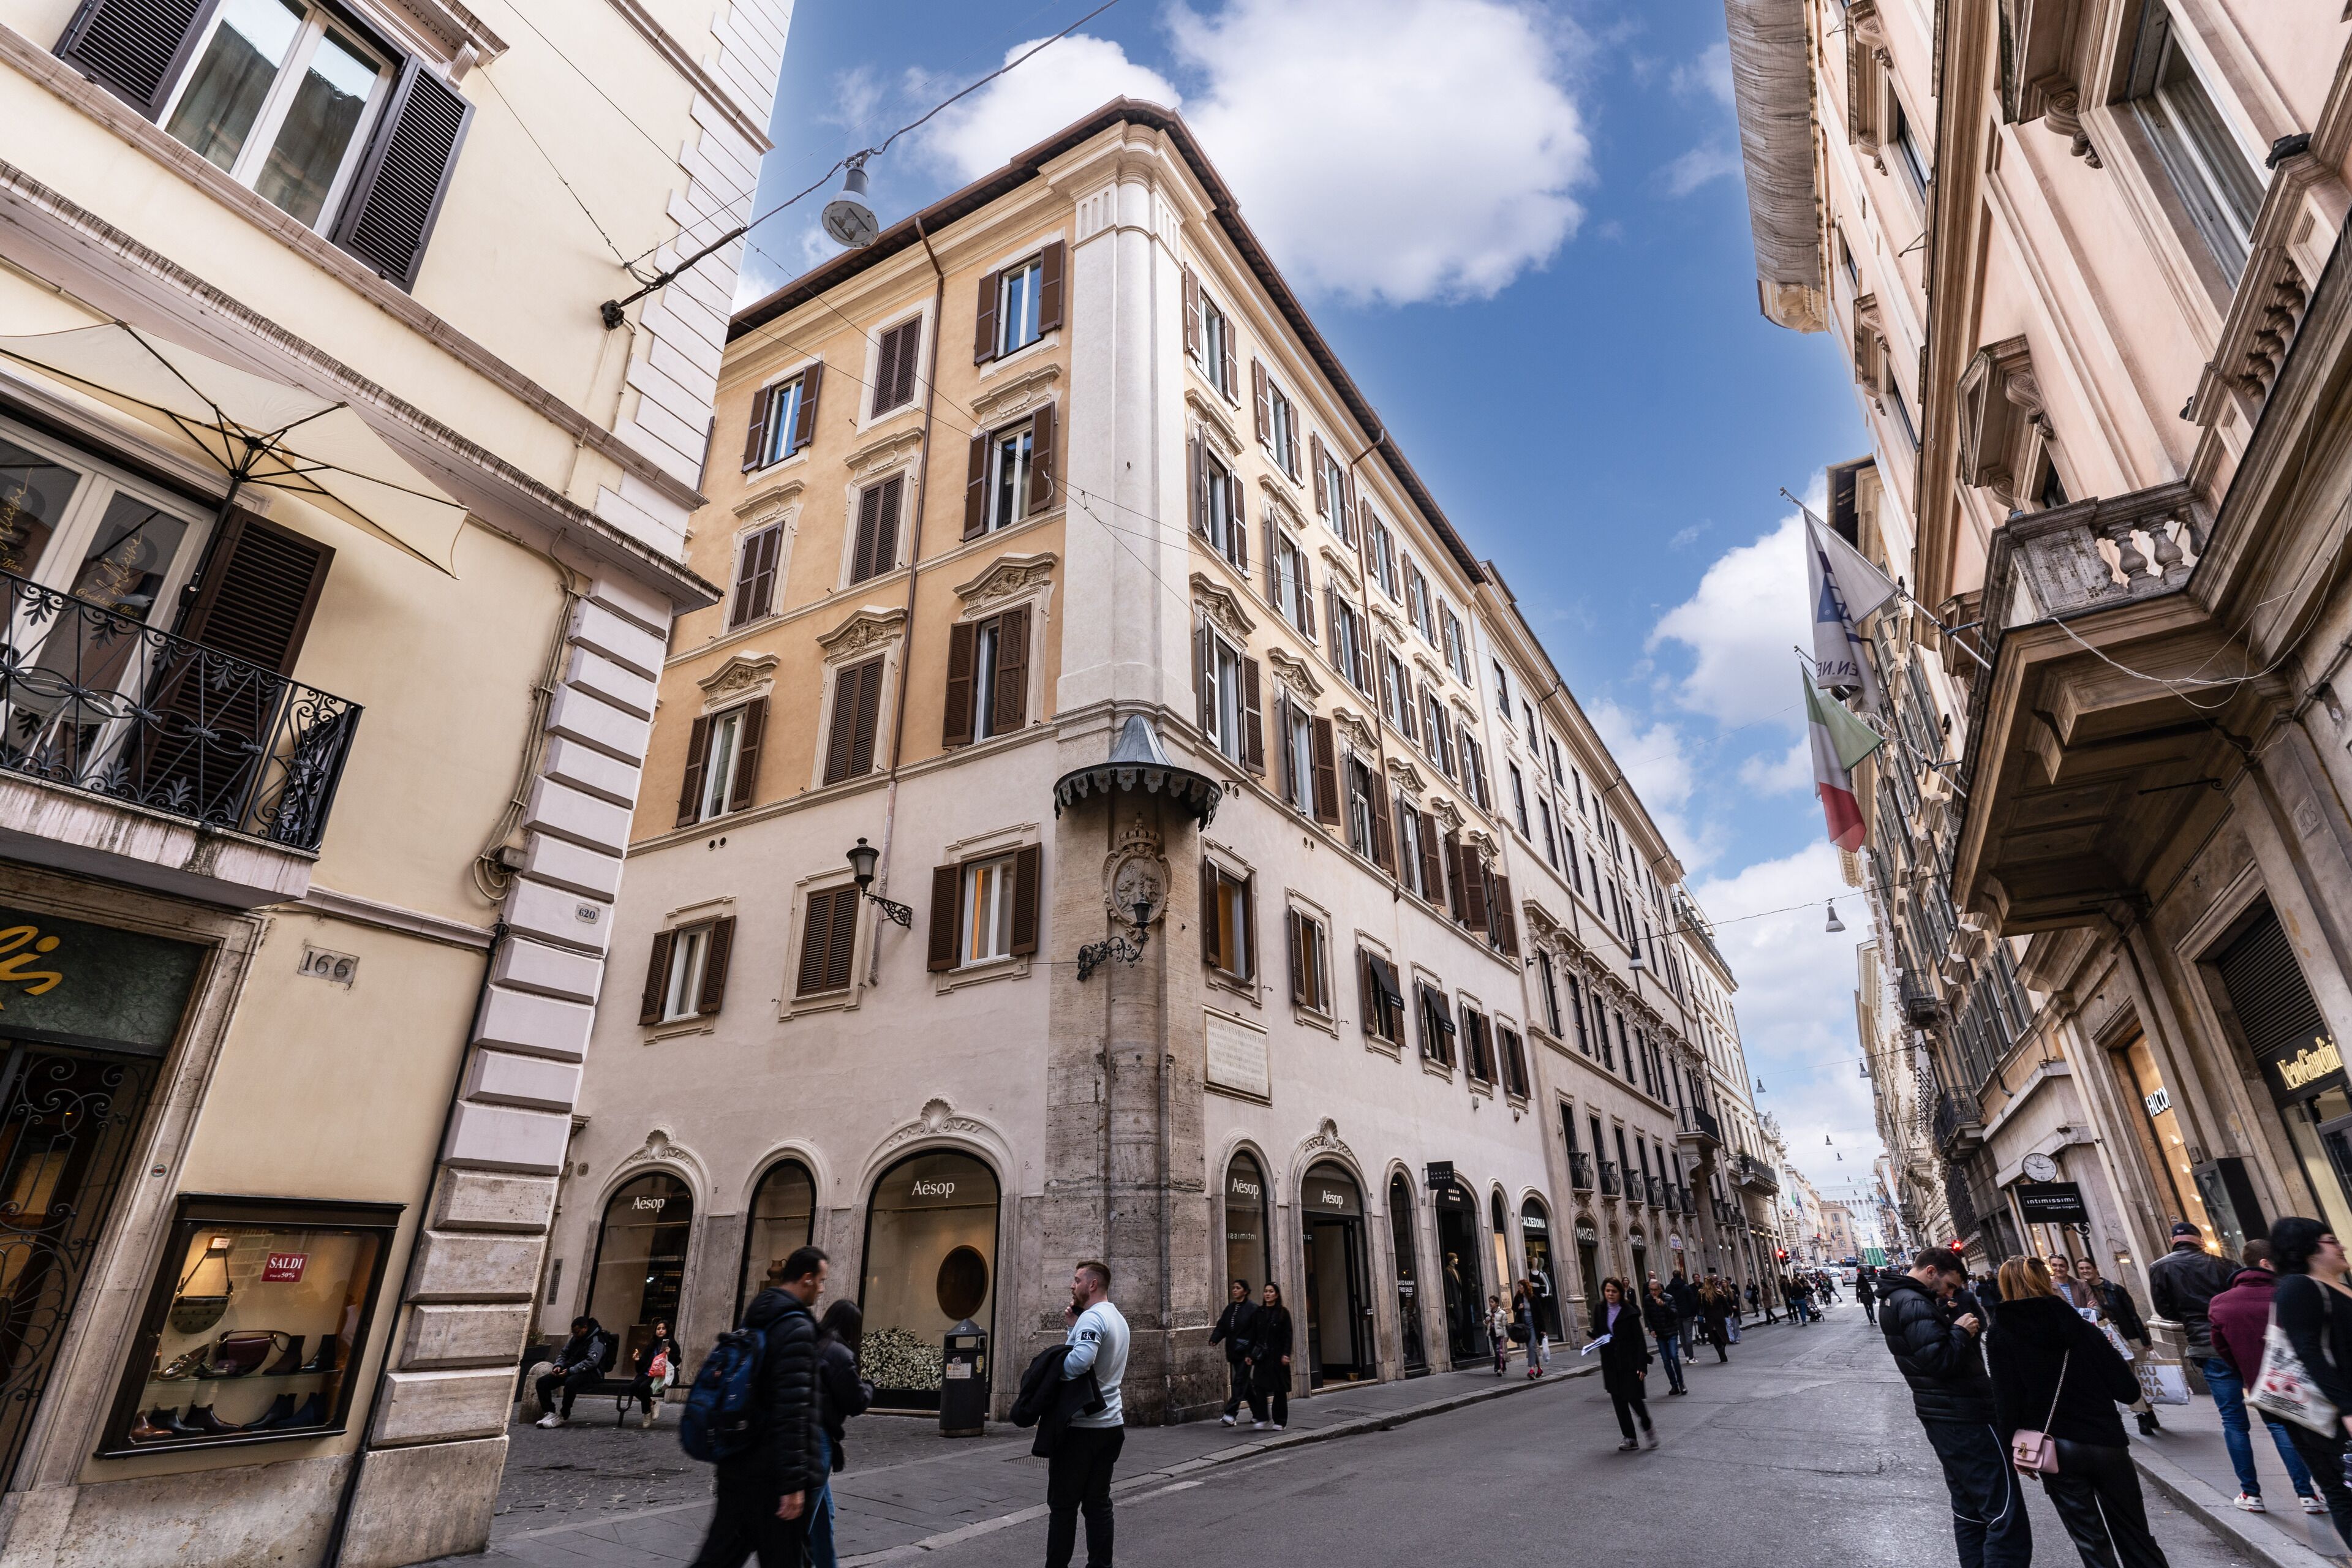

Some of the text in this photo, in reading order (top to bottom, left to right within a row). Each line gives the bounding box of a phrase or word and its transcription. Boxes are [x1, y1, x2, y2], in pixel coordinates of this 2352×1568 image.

[2, 558, 24, 572] Bar
[75, 588, 140, 617] Cocktail Bar
[303, 951, 353, 977] 166
[911, 1180, 955, 1199] Aēsop
[631, 1196, 665, 1213] Aēsop
[1576, 1226, 1595, 1241] MANGO
[269, 1257, 304, 1269] SALDI
[2136, 1366, 2157, 1376] HU
[2140, 1376, 2164, 1387] MA
[2143, 1387, 2167, 1397] NA
